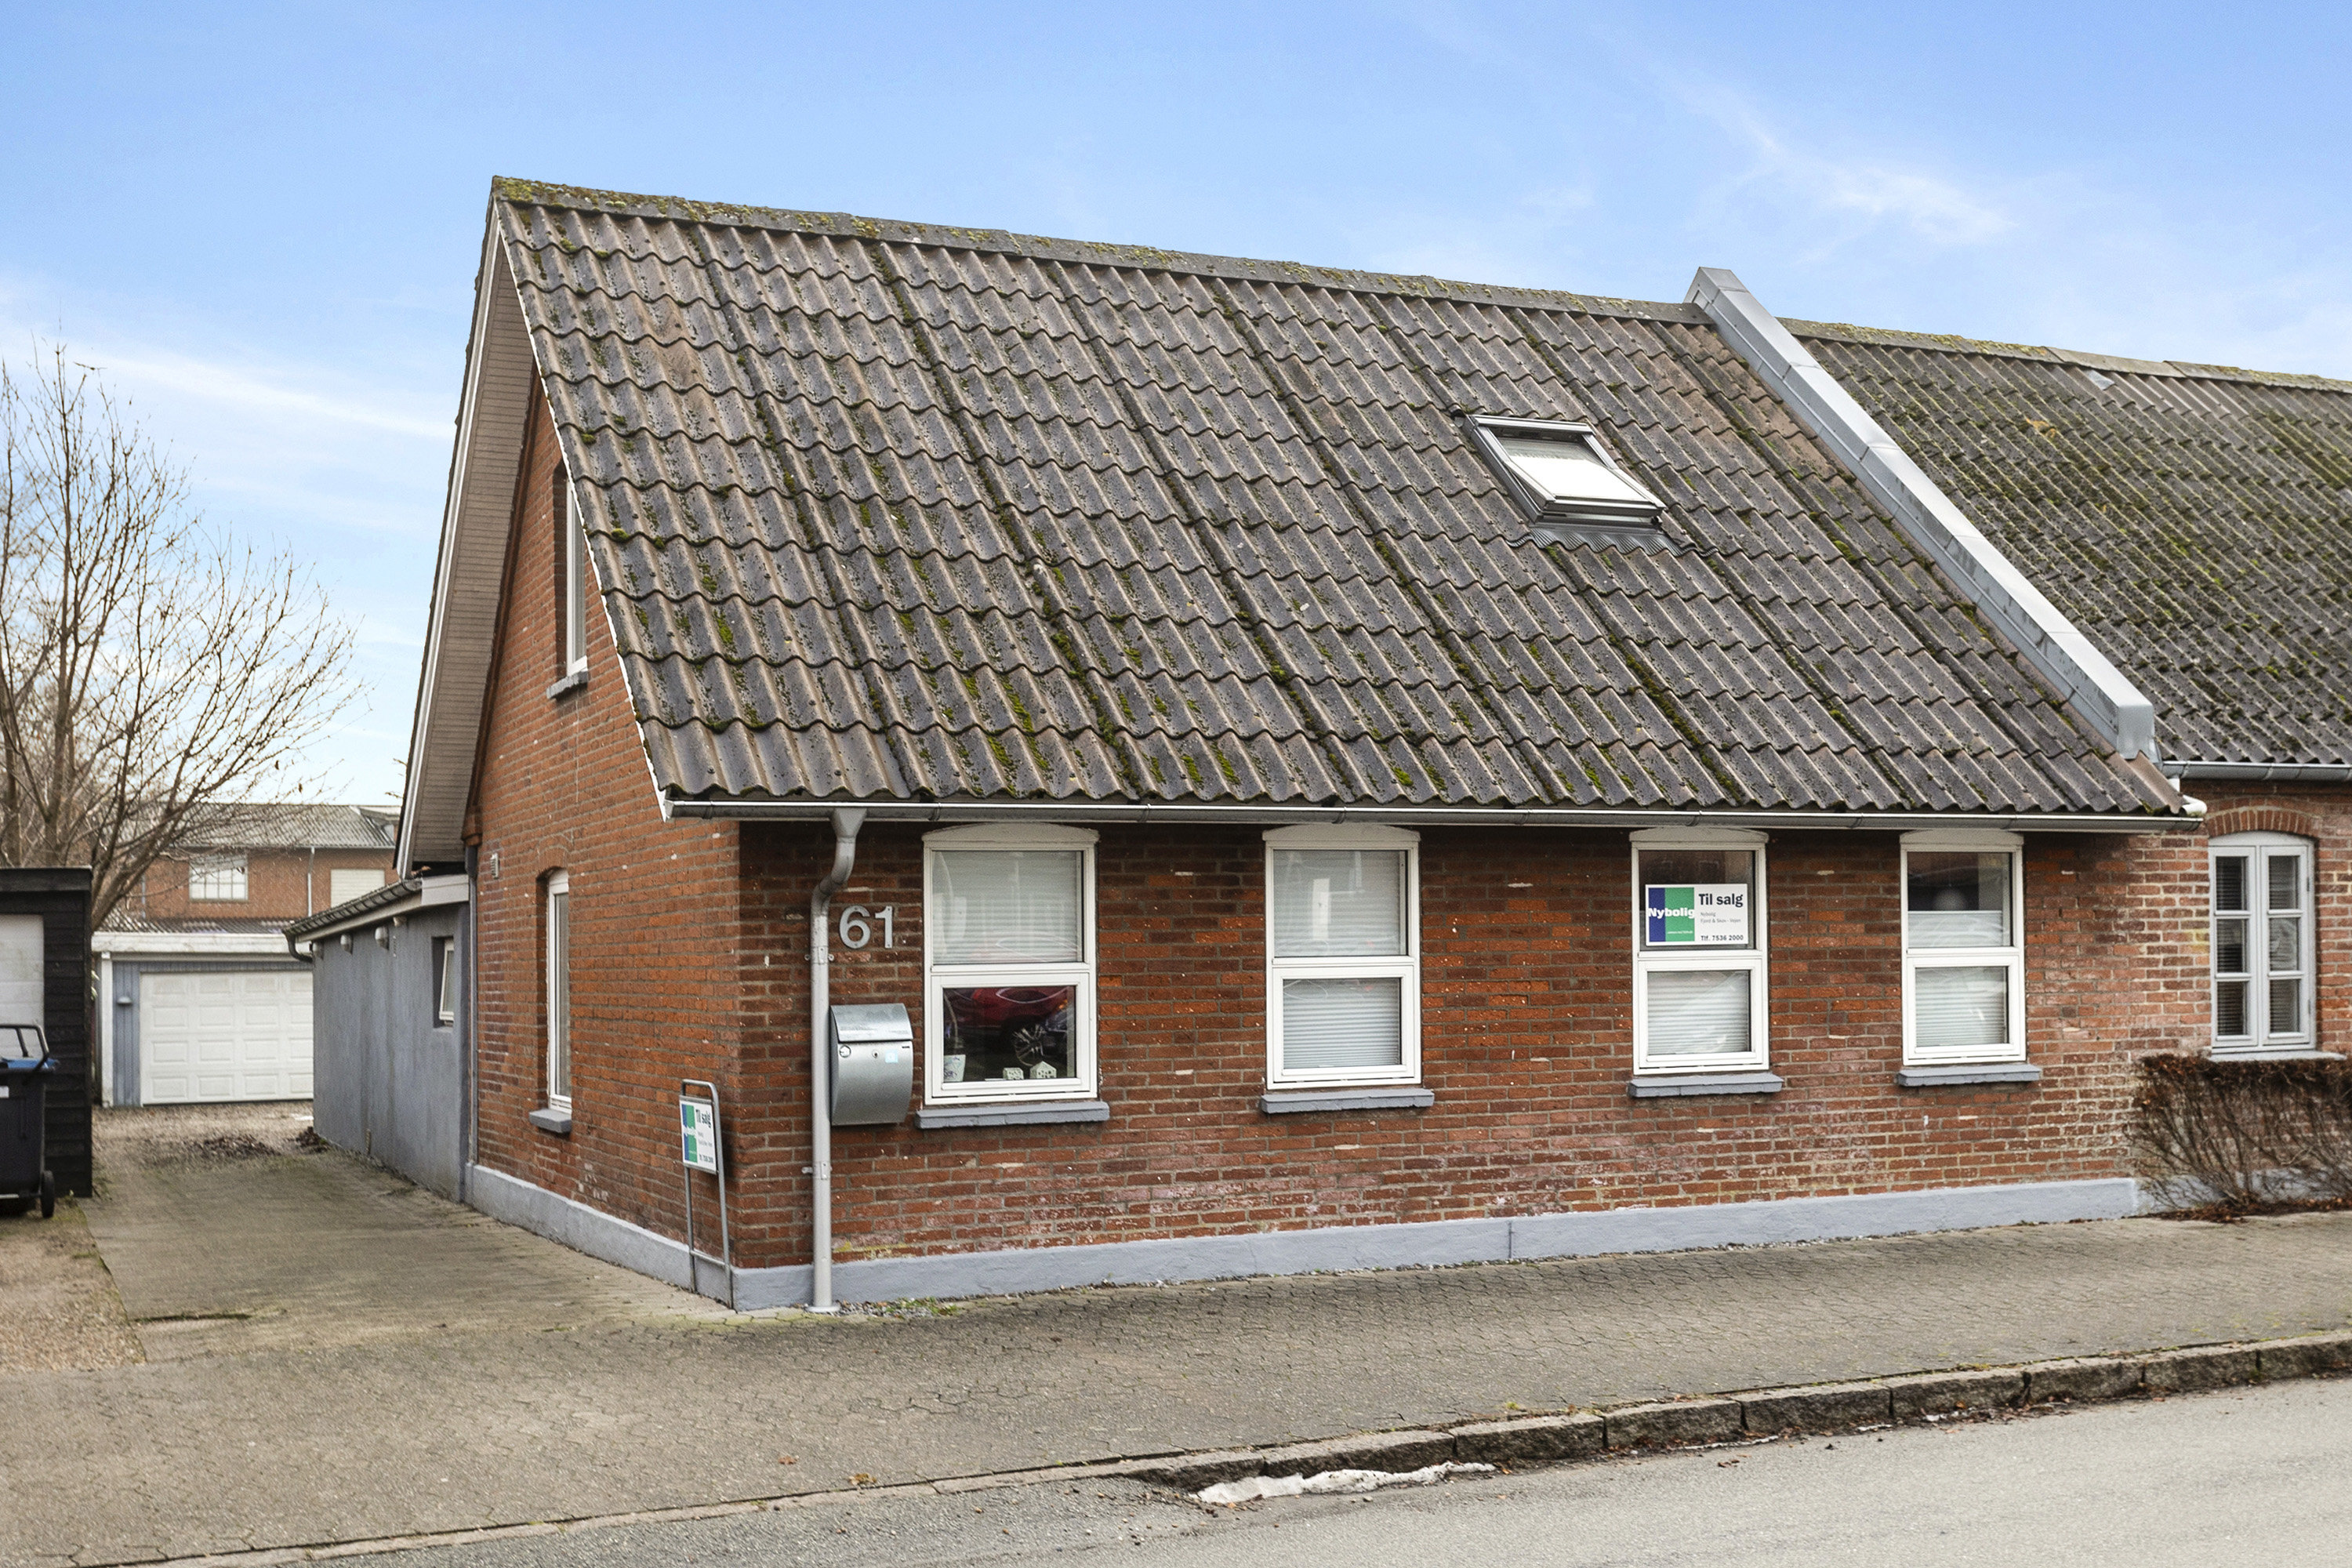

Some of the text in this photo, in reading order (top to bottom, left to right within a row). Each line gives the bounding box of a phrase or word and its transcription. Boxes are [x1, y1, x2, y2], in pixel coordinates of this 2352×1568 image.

[1698, 893, 1744, 907] Til salg
[1648, 907, 1695, 919] Nybolig
[839, 905, 893, 949] 61
